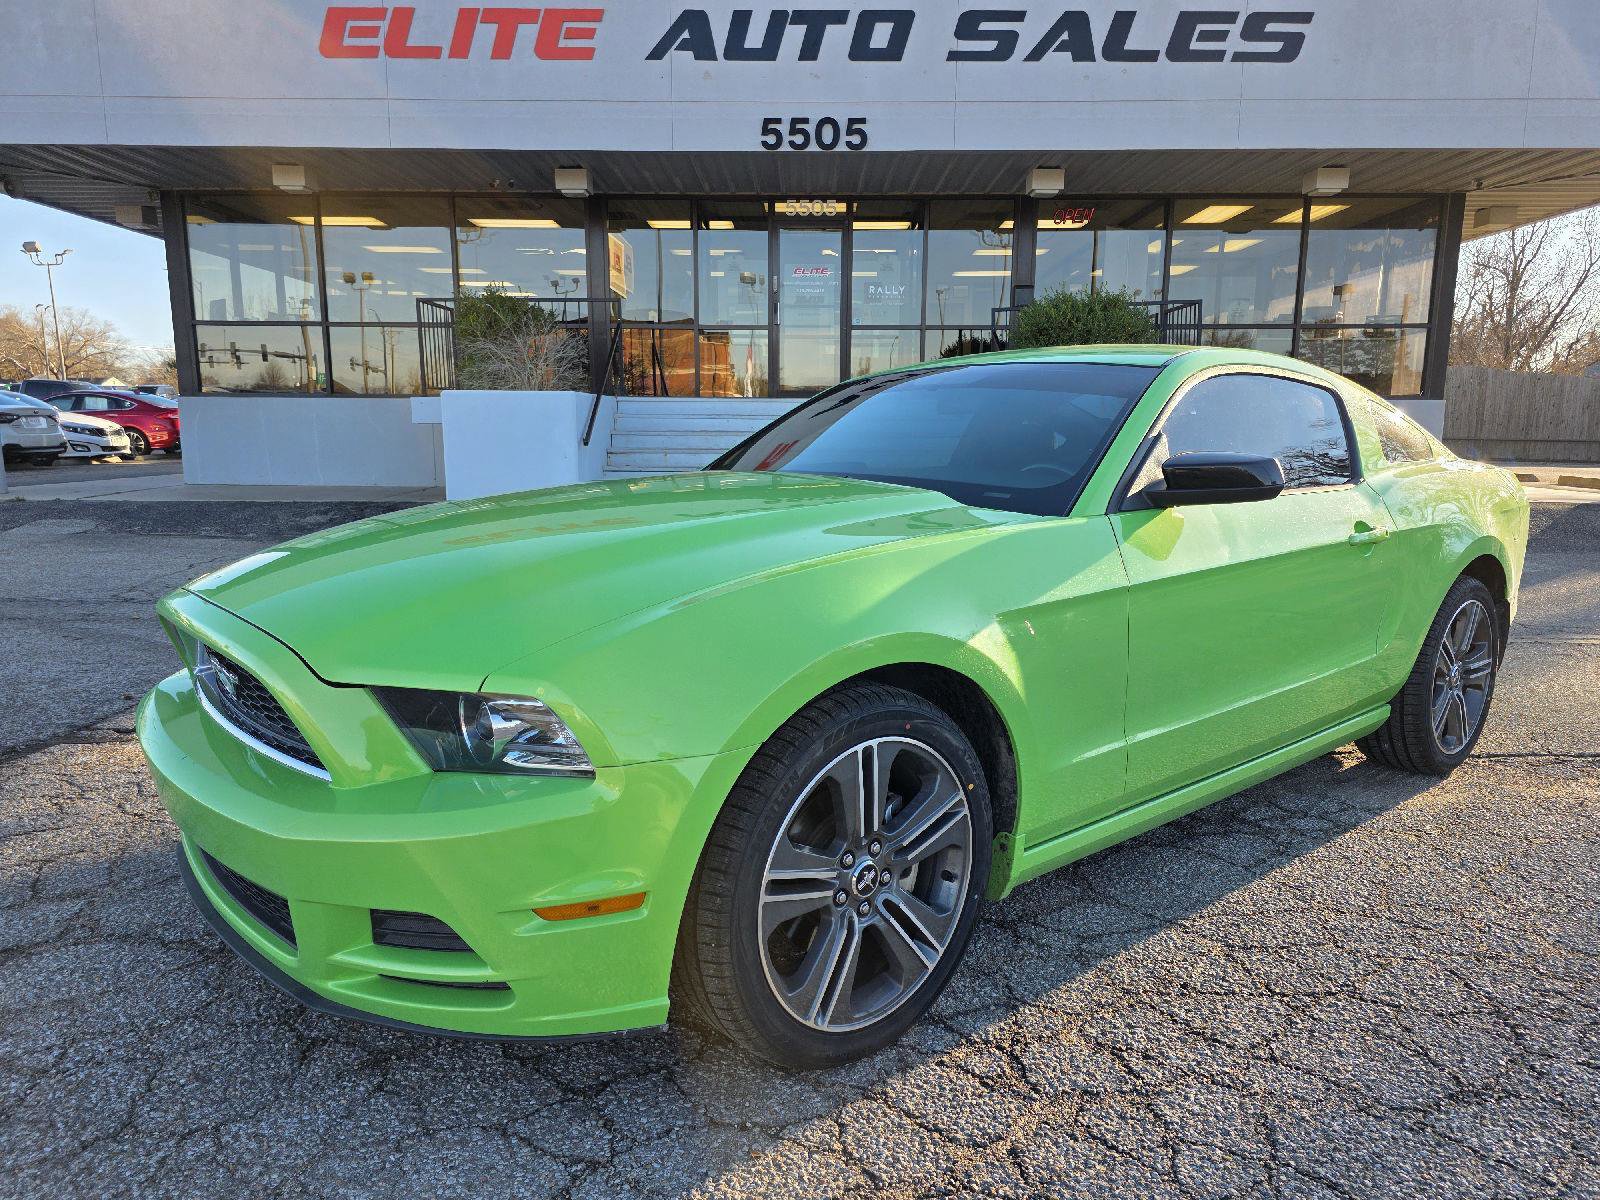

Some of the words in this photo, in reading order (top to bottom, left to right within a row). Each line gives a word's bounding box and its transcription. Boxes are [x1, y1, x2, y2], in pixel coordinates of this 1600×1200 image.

[319, 7, 604, 60] ELITE
[645, 10, 915, 62] AUTO
[946, 10, 1314, 62] SALES
[761, 117, 868, 154] 5505
[785, 200, 836, 216] 5505
[1053, 208, 1096, 225] OPEN
[793, 267, 830, 275] ELITE
[869, 285, 905, 294] RALLY
